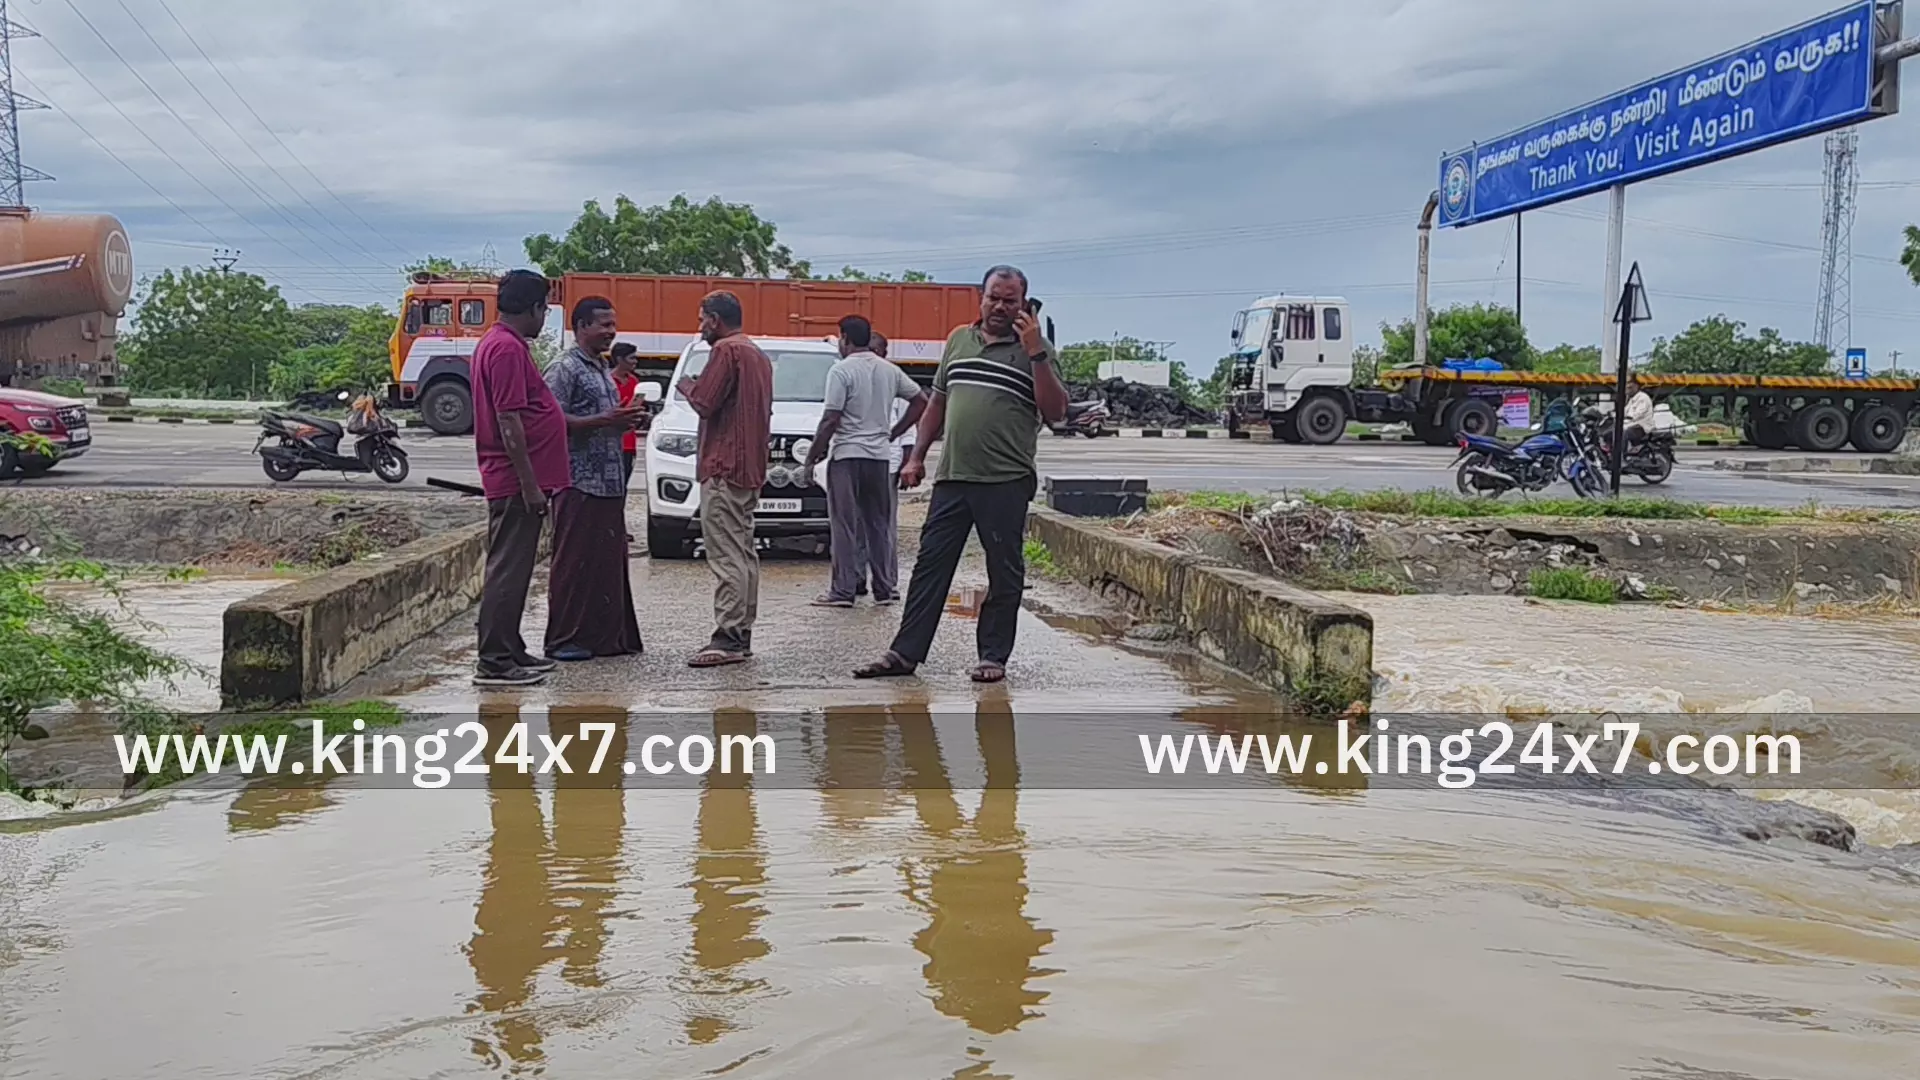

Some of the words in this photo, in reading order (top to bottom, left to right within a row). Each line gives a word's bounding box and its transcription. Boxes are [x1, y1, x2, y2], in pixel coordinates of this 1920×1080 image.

[1476, 141, 1521, 179] தங்கள்
[1524, 113, 1606, 158] வருகைக்கு
[1610, 87, 1667, 136] நன்றி!
[1678, 52, 1766, 106] மீண்டும்
[1775, 20, 1861, 72] வருக!!
[1529, 156, 1577, 191] Thank
[1585, 148, 1624, 174] You,
[1635, 124, 1679, 161] Visit
[1688, 104, 1754, 147] Again
